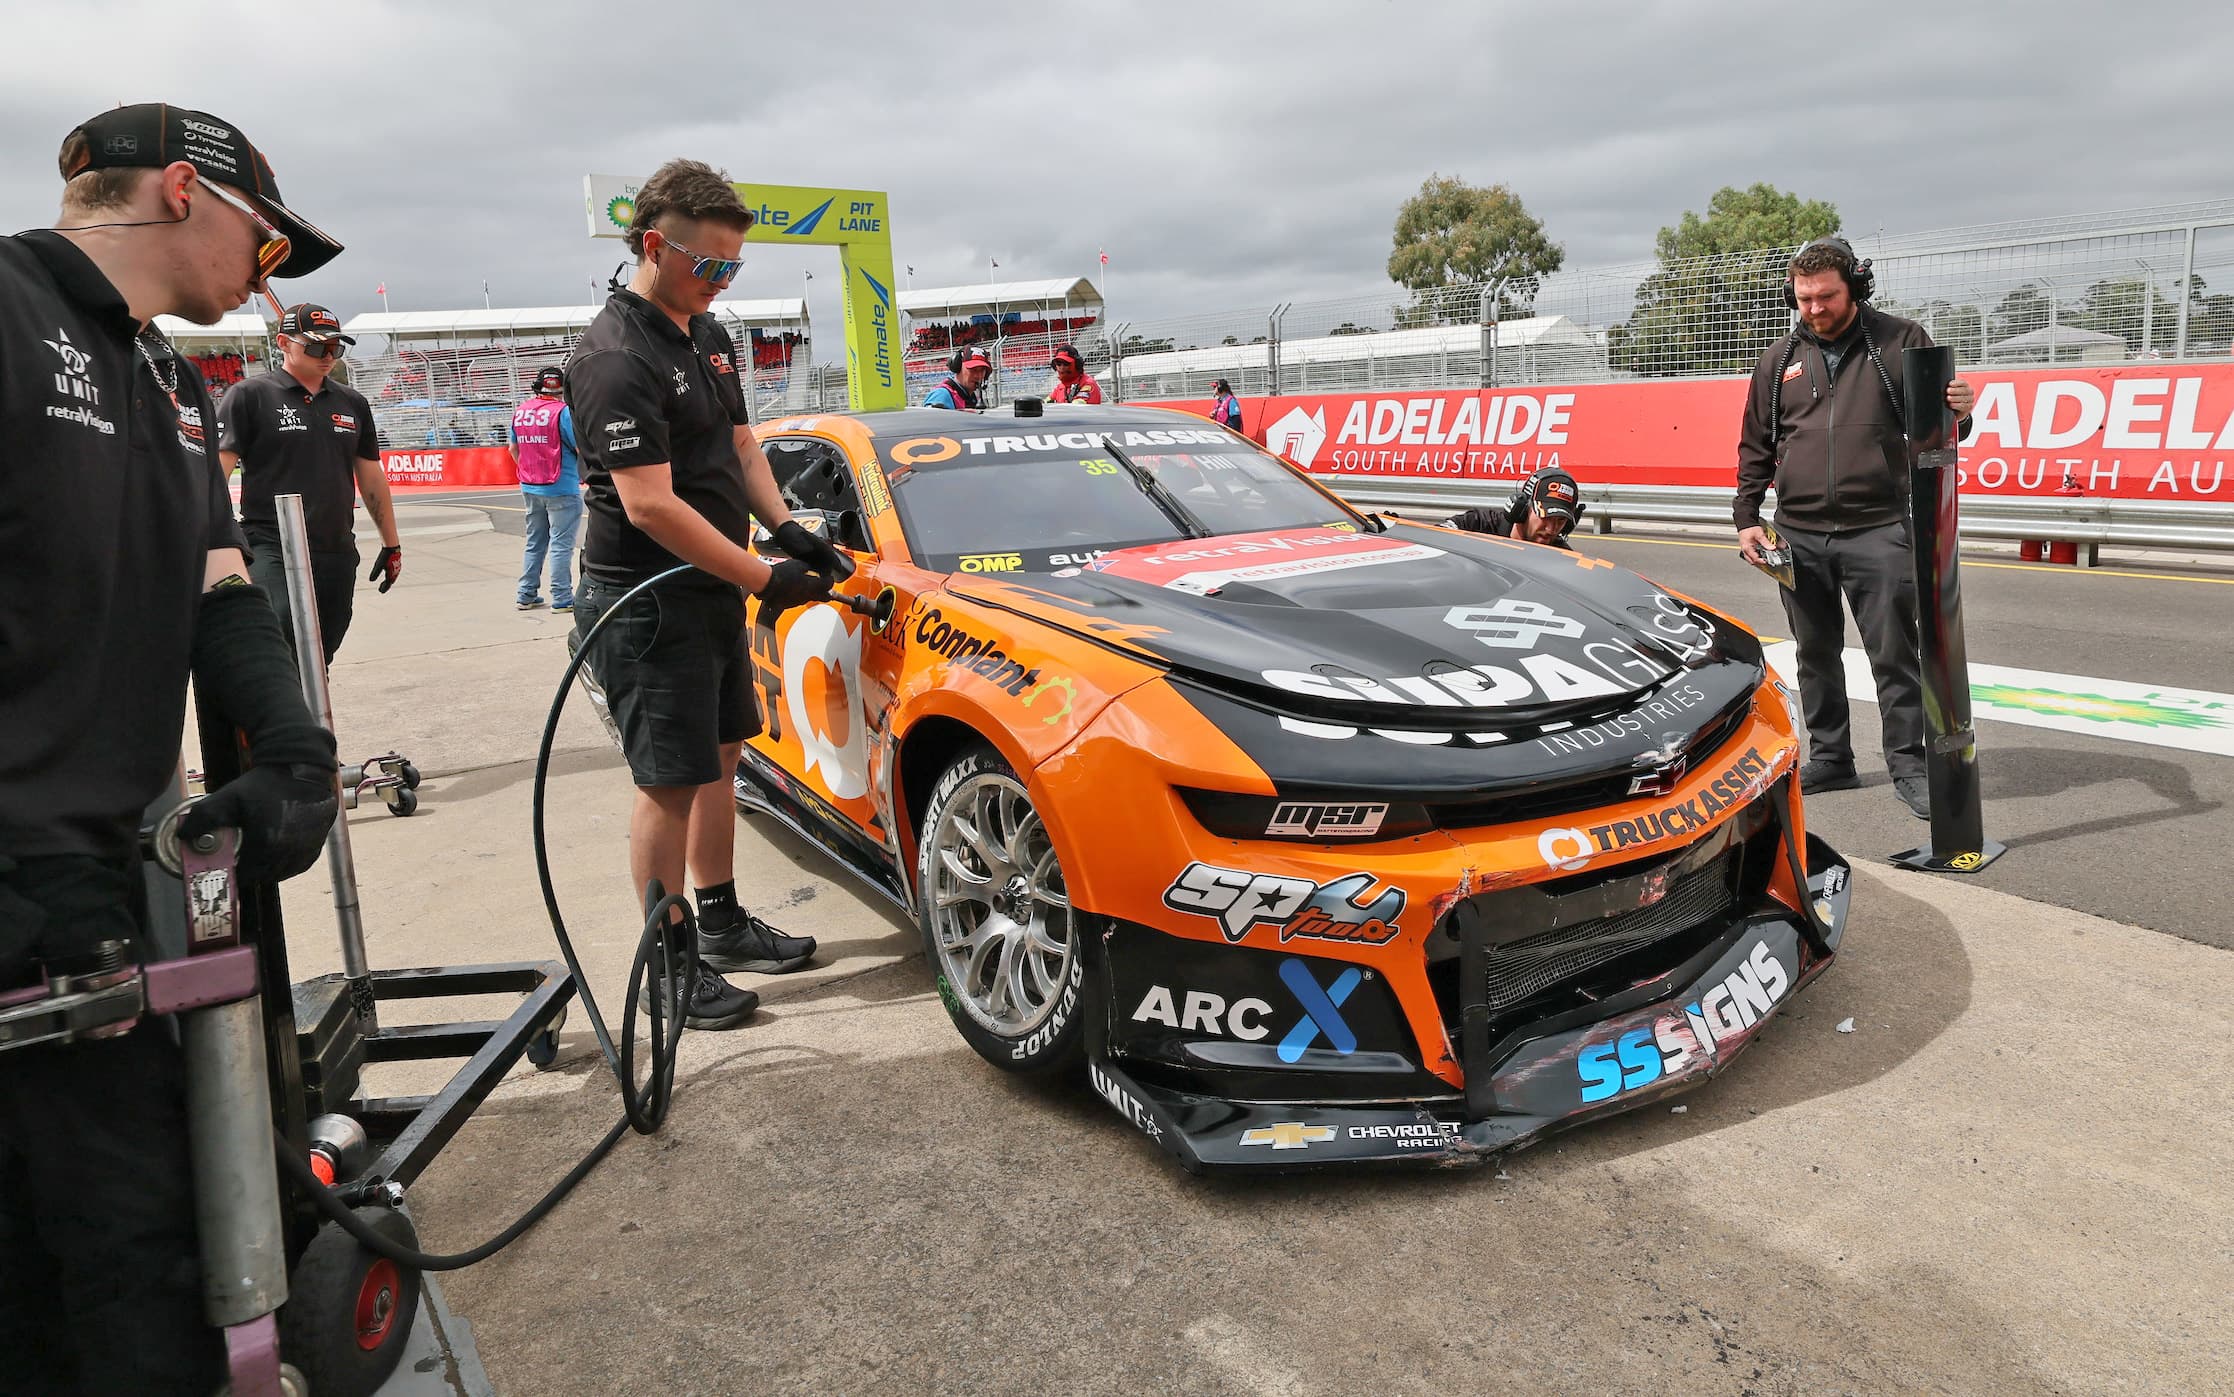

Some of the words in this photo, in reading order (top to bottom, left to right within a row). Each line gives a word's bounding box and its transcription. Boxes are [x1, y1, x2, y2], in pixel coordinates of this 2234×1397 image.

[850, 202, 874, 216] PIT
[840, 218, 880, 232] LANE
[872, 304, 892, 388] ultimate
[55, 373, 99, 405] UNIT
[46, 405, 116, 435] retraVision
[514, 409, 551, 427] 253
[1336, 393, 1575, 446] ADELAIDE
[1958, 377, 2234, 450] ADEL
[962, 433, 1123, 455] TRUCK
[1125, 430, 1240, 447] ASSIST
[387, 454, 443, 473] ADELAIDE
[387, 473, 409, 482] SOUTH
[410, 472, 443, 481] AUSTRALIA
[1079, 458, 1118, 476] 35
[1194, 455, 1238, 471] Hill
[1331, 450, 1406, 473] SOUTH
[1416, 451, 1560, 475] AUSTRALIA
[1956, 457, 2121, 491] SOUTH
[1144, 531, 1382, 565] retraVision
[959, 557, 1022, 573] OMP
[916, 608, 1041, 697] Conplant
[1537, 684, 1705, 758] INDUSTRIES
[940, 754, 978, 802] MAXX
[1589, 803, 1706, 852] TRUCK
[1703, 746, 1768, 818] ASSIST
[1011, 955, 1083, 1060] DUNLOP
